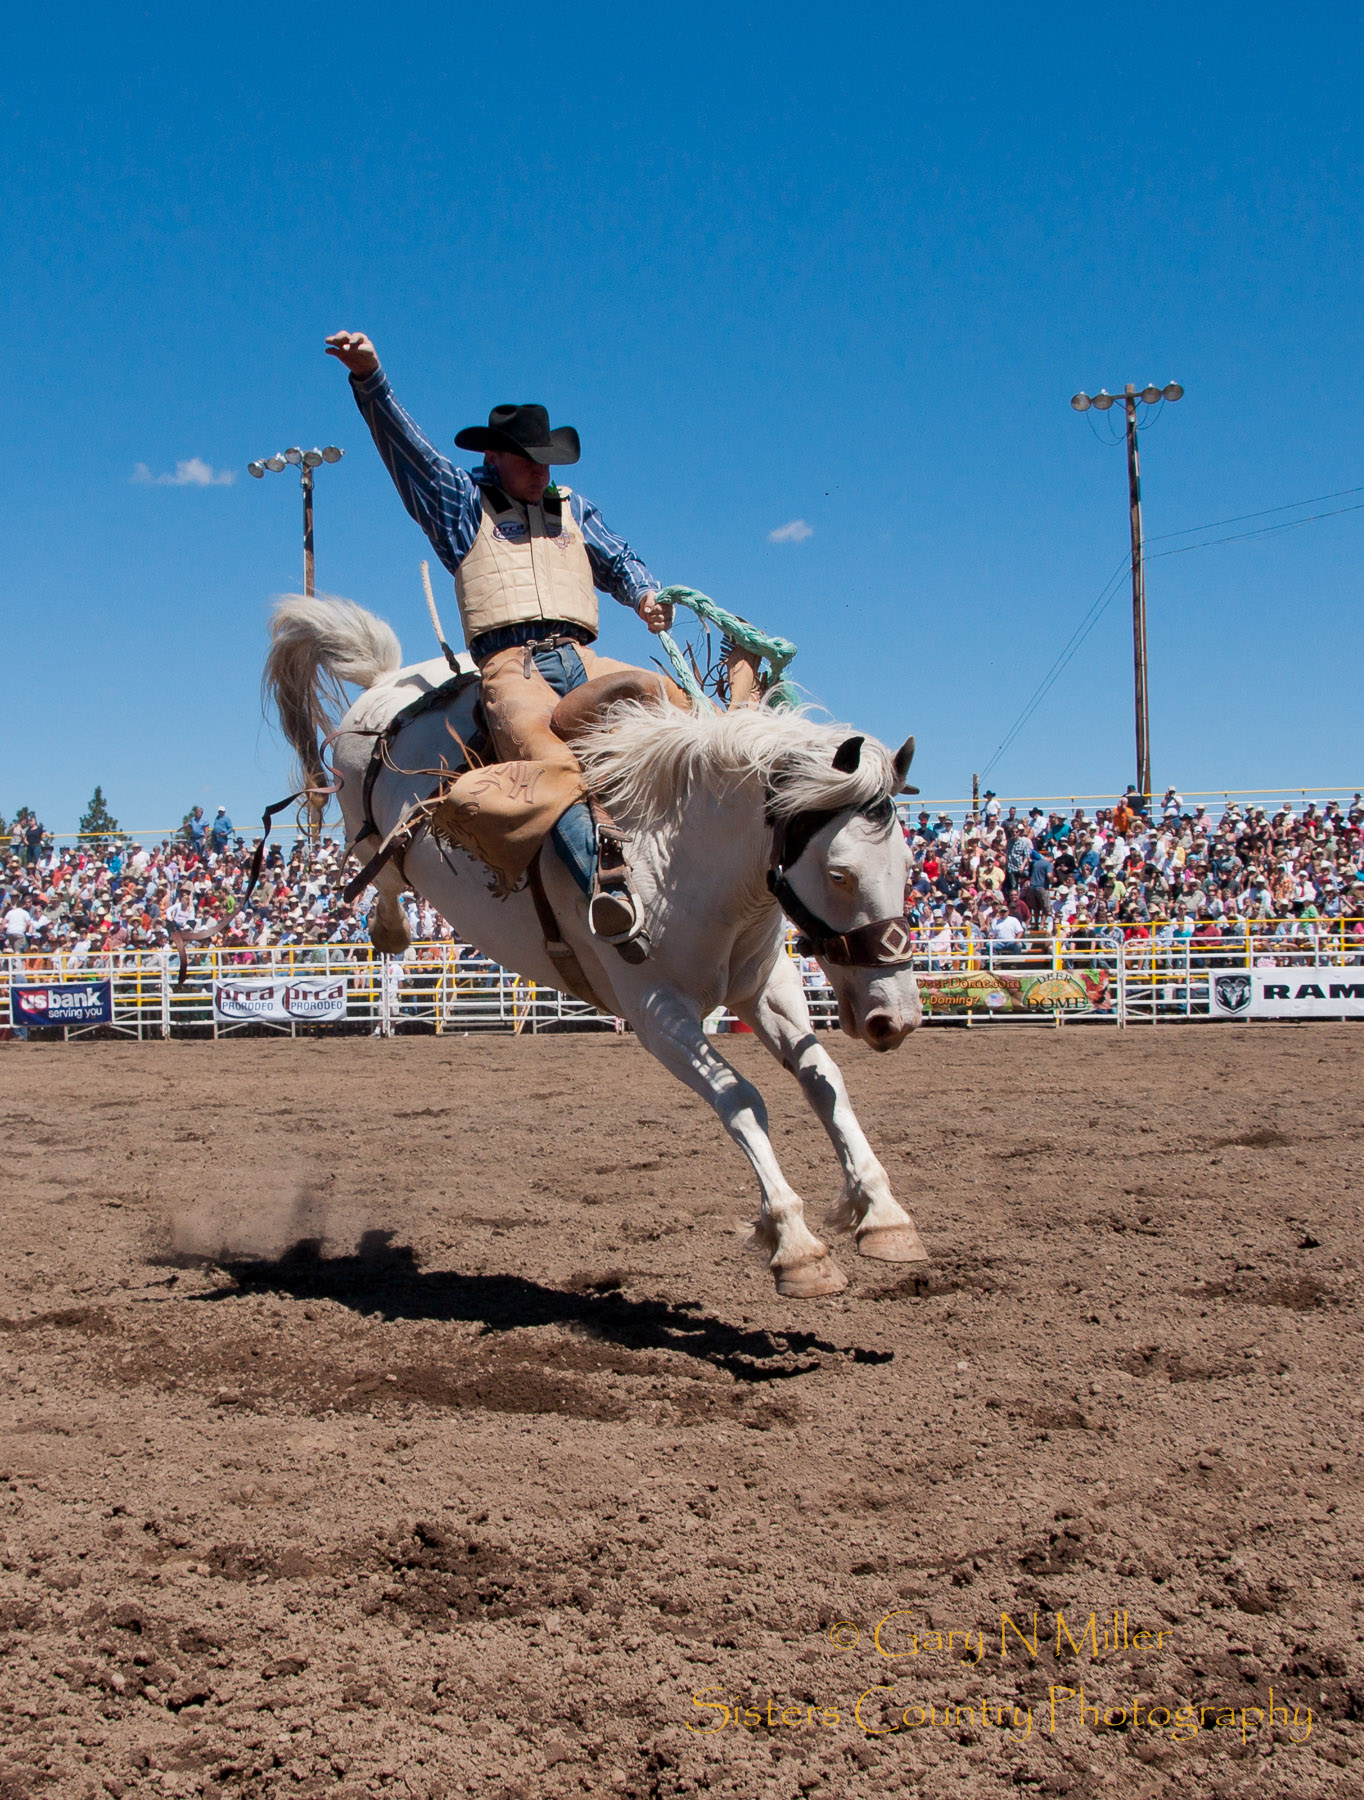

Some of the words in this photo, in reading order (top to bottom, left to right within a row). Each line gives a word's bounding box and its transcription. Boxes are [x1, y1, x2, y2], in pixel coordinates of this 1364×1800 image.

[1037, 972, 1072, 984] DEER
[285, 985, 344, 1010] prca
[1263, 984, 1364, 999] RAM
[217, 986, 275, 1011] prca
[930, 995, 980, 1007] Doming?
[1026, 997, 1087, 1009] DOME
[222, 1001, 274, 1011] PRORODEO
[290, 1000, 343, 1011] PRORODEO
[48, 1008, 83, 1019] serving
[84, 1007, 103, 1018] you
